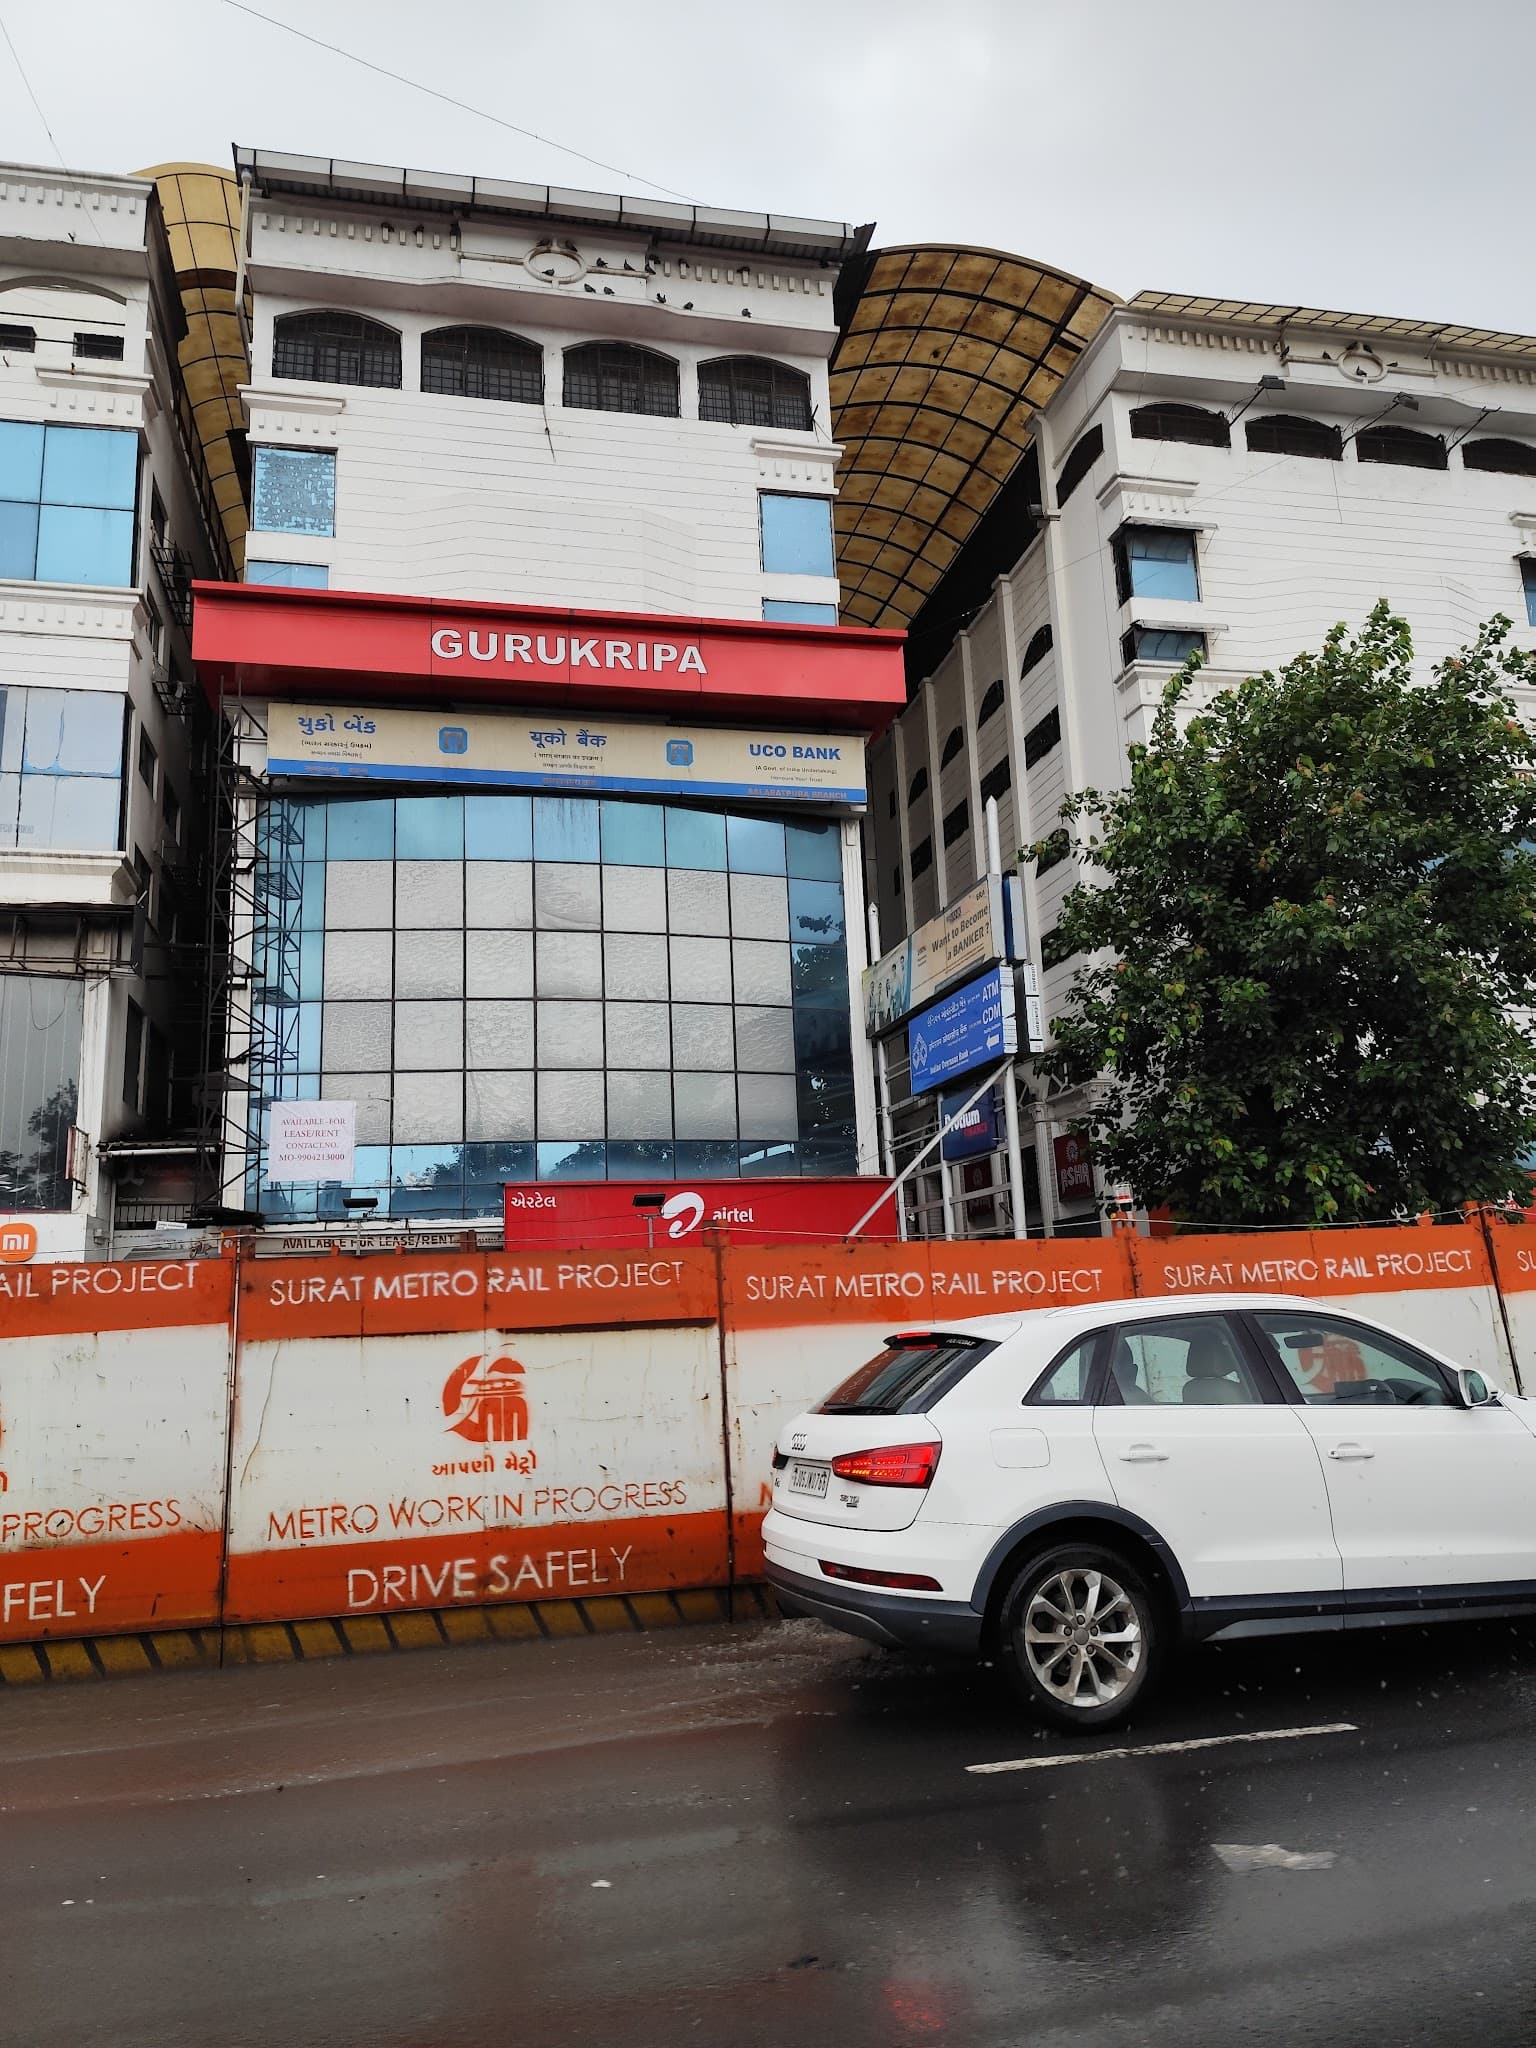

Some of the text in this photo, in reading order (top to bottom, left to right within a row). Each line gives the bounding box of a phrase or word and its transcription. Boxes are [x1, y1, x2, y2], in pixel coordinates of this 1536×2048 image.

[430, 628, 708, 675] GURUKRIPA
[529, 728, 608, 749] यूको बैंक
[749, 743, 842, 761] UCO BANK
[931, 932, 951, 953] Want
[952, 926, 959, 939] to
[960, 905, 989, 933] Become
[982, 978, 999, 1003] ATM
[982, 1001, 1001, 1025] CDM
[280, 1117, 325, 1126] AVAILABLE
[284, 1129, 339, 1138] LEASE/RENT
[510, 1191, 557, 1209] એરટેલ
[712, 1206, 754, 1223] airtel
[282, 1237, 346, 1249] AVAILABLE
[379, 1233, 455, 1248] LEASE/RENT
[51, 1261, 200, 1296] PROJECT
[269, 1261, 684, 1306] SURAT METRO RAIL PROJECT
[1163, 1249, 1473, 1290] SURAT METRO RAIL PROJECT
[746, 1268, 1103, 1301] SURAT METRO RAIL PROJECT
[431, 1448, 538, 1477] આપણી મેટ્રો
[2, 1499, 182, 1543] PROGRESS
[267, 1480, 688, 1542] METRO WORK IN PROGRESS
[347, 1544, 633, 1608] DRIVE SAFELY
